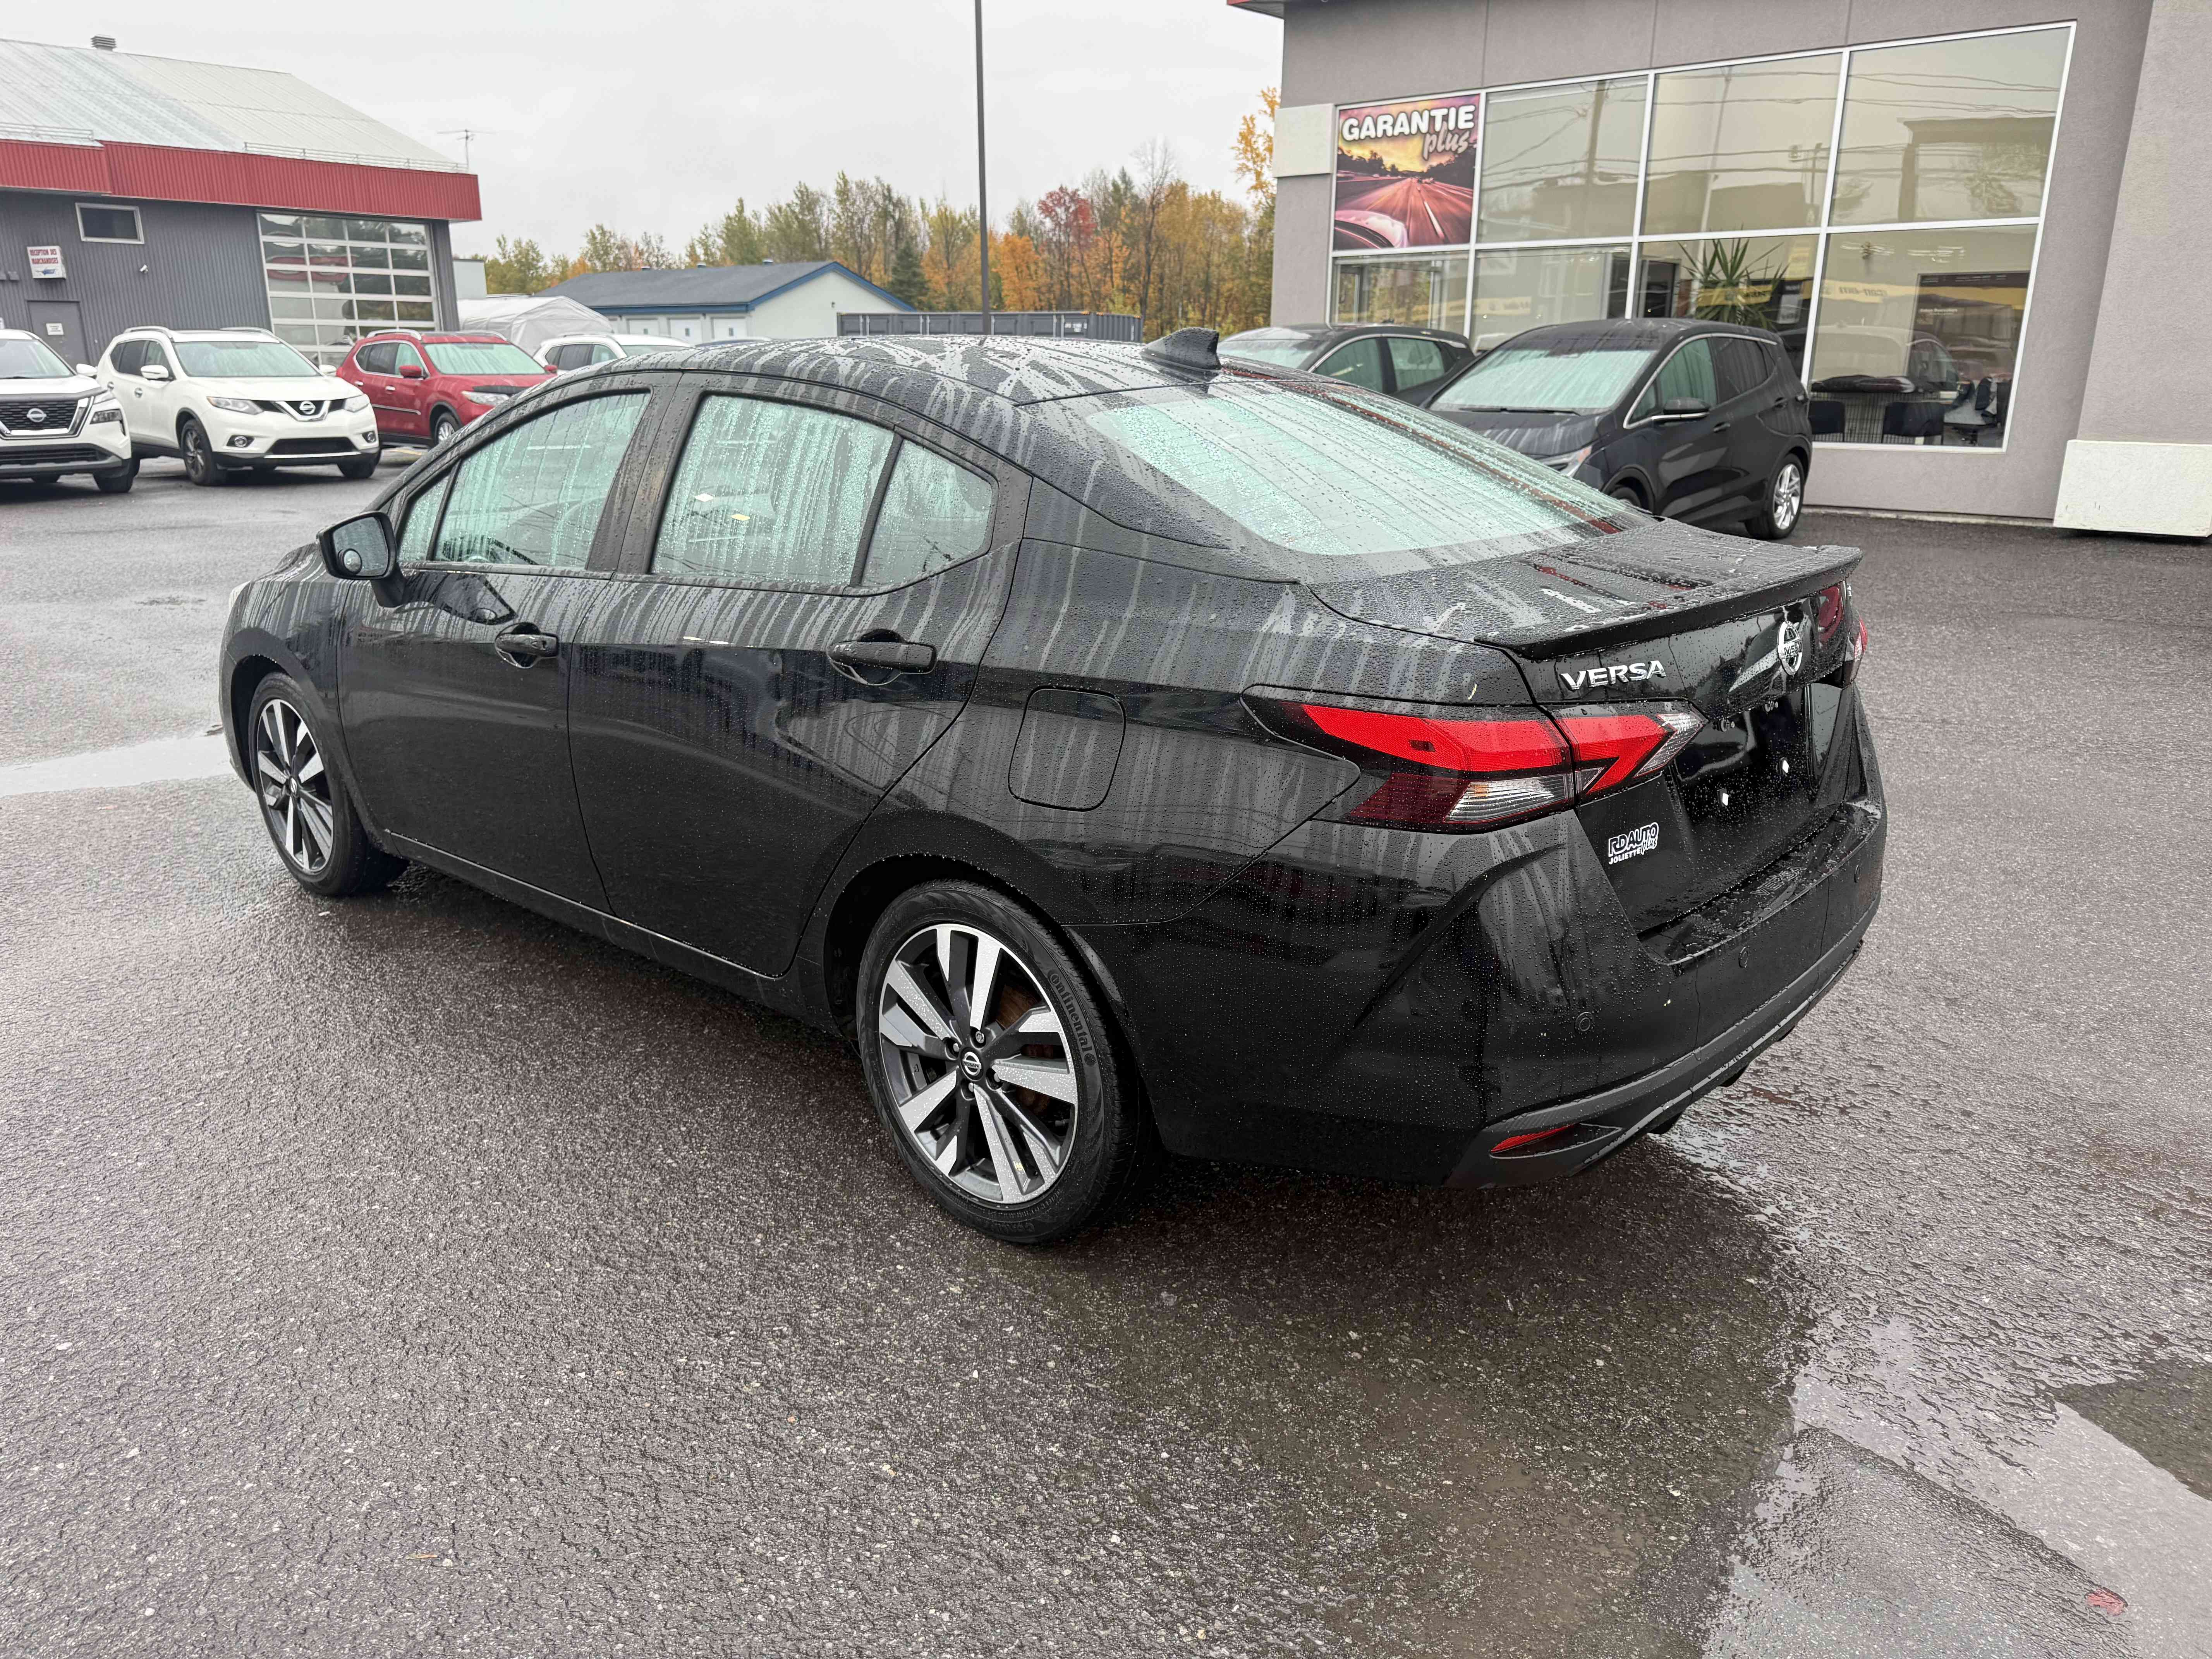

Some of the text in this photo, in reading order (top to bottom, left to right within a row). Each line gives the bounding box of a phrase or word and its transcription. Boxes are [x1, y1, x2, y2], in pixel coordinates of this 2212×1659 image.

[1341, 105, 1476, 141] GARANTIE
[1422, 121, 1470, 161] plus
[1559, 660, 1666, 692] VERSA
[1609, 847, 1641, 865] JOLIETTE
[1749, 866, 1807, 895] VERSA
[1047, 969, 1092, 1053] Continental
